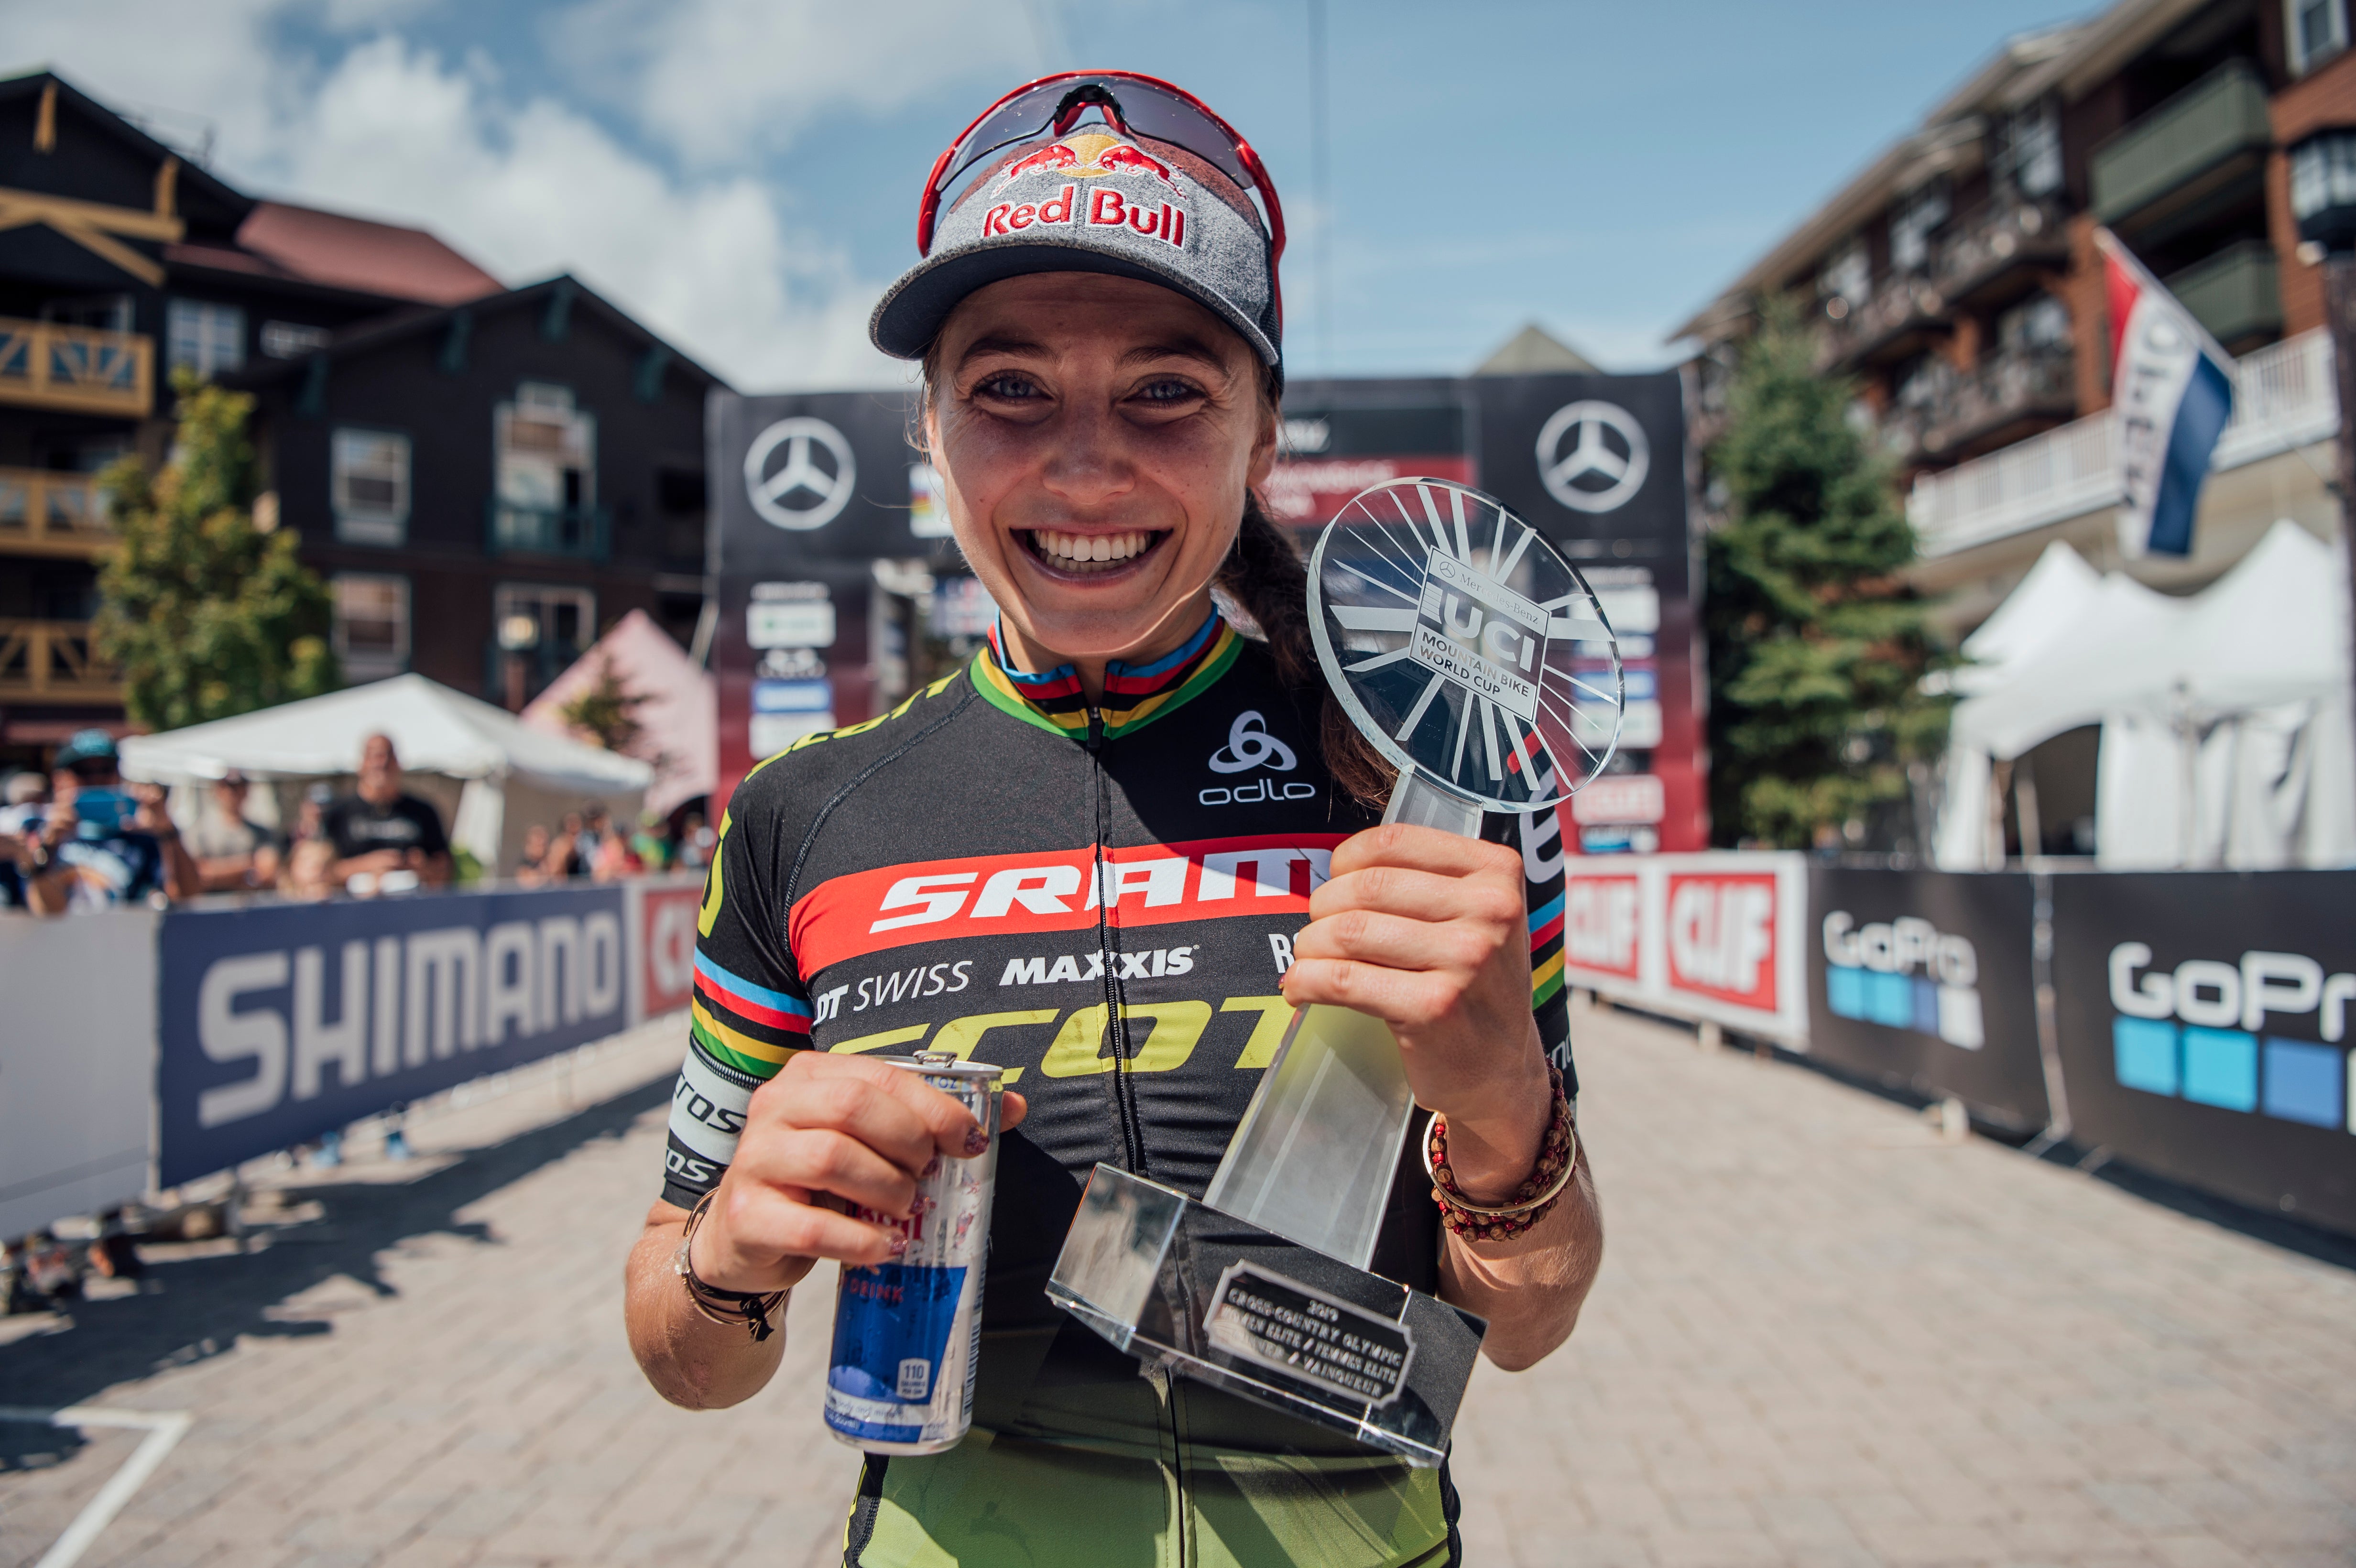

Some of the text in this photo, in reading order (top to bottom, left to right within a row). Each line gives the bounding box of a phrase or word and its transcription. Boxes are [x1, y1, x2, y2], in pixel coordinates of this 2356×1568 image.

[982, 185, 1185, 249] Red Bull
[1460, 573, 1538, 624] Mercedes-Benz
[1422, 632, 1529, 697] MOUNTAIN BIKE
[1443, 593, 1536, 672] UCI
[1419, 644, 1501, 695] WORLD CUP
[1199, 779, 1315, 805] odlo
[868, 848, 1333, 934] SRAM
[1672, 878, 1772, 996] CLIF
[1822, 909, 1978, 987] GoPro
[196, 909, 621, 1129] SHIMANO
[813, 960, 973, 1026] DT SWISS
[2107, 941, 2356, 1043] GoPr
[904, 1364, 925, 1379] 110
[1342, 1332, 1403, 1367] OLYMPIC
